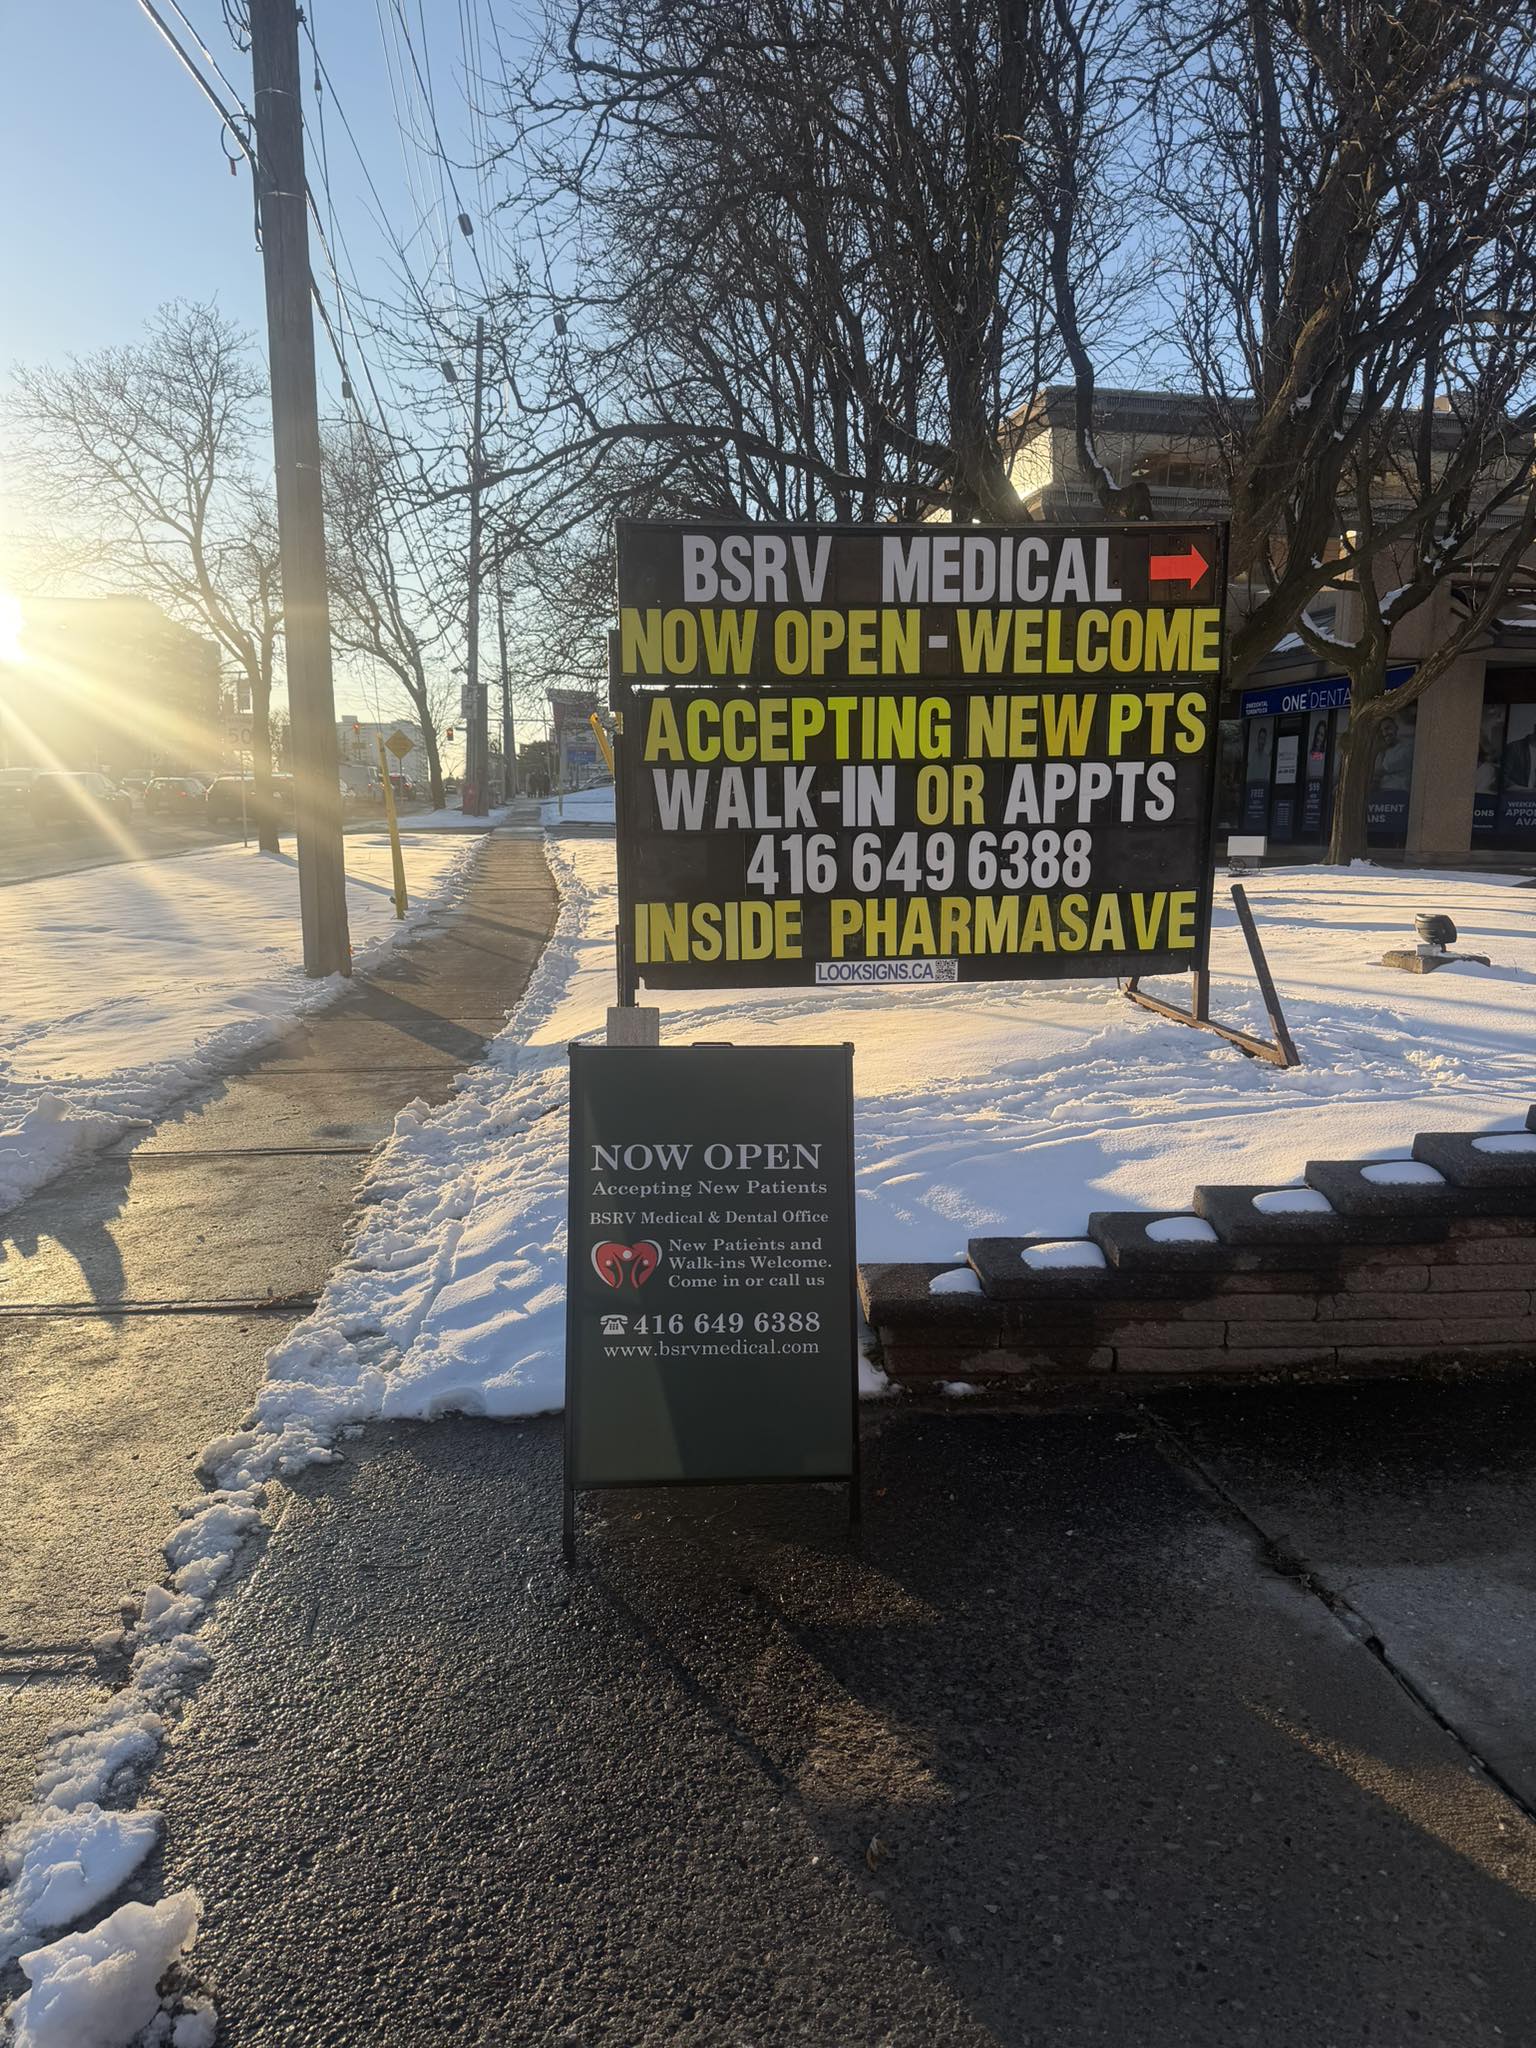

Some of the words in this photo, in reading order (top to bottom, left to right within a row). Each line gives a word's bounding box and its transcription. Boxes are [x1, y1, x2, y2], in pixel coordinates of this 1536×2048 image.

[683, 535, 832, 603] BSRV
[881, 536, 1122, 603] MEDICAL
[621, 608, 758, 675] NOW
[1310, 687, 1352, 709] DENTA
[644, 696, 952, 761] ACCEPTING
[968, 694, 1097, 759] NEW
[1108, 692, 1207, 757] PTS
[652, 765, 896, 831] WALK-IN
[916, 764, 985, 826] OR
[1003, 761, 1176, 825] APPTS
[1368, 804, 1405, 812] YMENT
[747, 834, 837, 895] 416
[851, 831, 955, 893] 649
[967, 829, 1093, 889] 6388
[635, 900, 803, 964] INSIDE
[830, 891, 1197, 958] PHARMASAVE
[817, 963, 934, 981] LOOKSIGNS.CA
[590, 1144, 694, 1171] NOW
[704, 1143, 822, 1170] OPEN
[592, 1182, 692, 1198] Accepting
[698, 1180, 740, 1195] New
[747, 1180, 828, 1194] Patients
[590, 1212, 636, 1225] BSRV
[641, 1210, 702, 1224] Medical
[708, 1211, 721, 1224] &
[726, 1210, 777, 1224] Dental
[782, 1209, 829, 1223] Office
[669, 1239, 706, 1251] New
[713, 1238, 785, 1251] Patients
[790, 1238, 822, 1250] and
[669, 1257, 746, 1269] Walk-ins
[750, 1256, 832, 1268] Welcome.
[668, 1275, 717, 1288] Come
[723, 1275, 739, 1287] in
[745, 1277, 764, 1287] or
[769, 1274, 800, 1287] call
[806, 1276, 825, 1286] us
[633, 1313, 684, 1335] 416
[694, 1313, 744, 1334] 649
[754, 1312, 821, 1333] 6388
[603, 1340, 819, 1357] www.bsrvmedical.com
